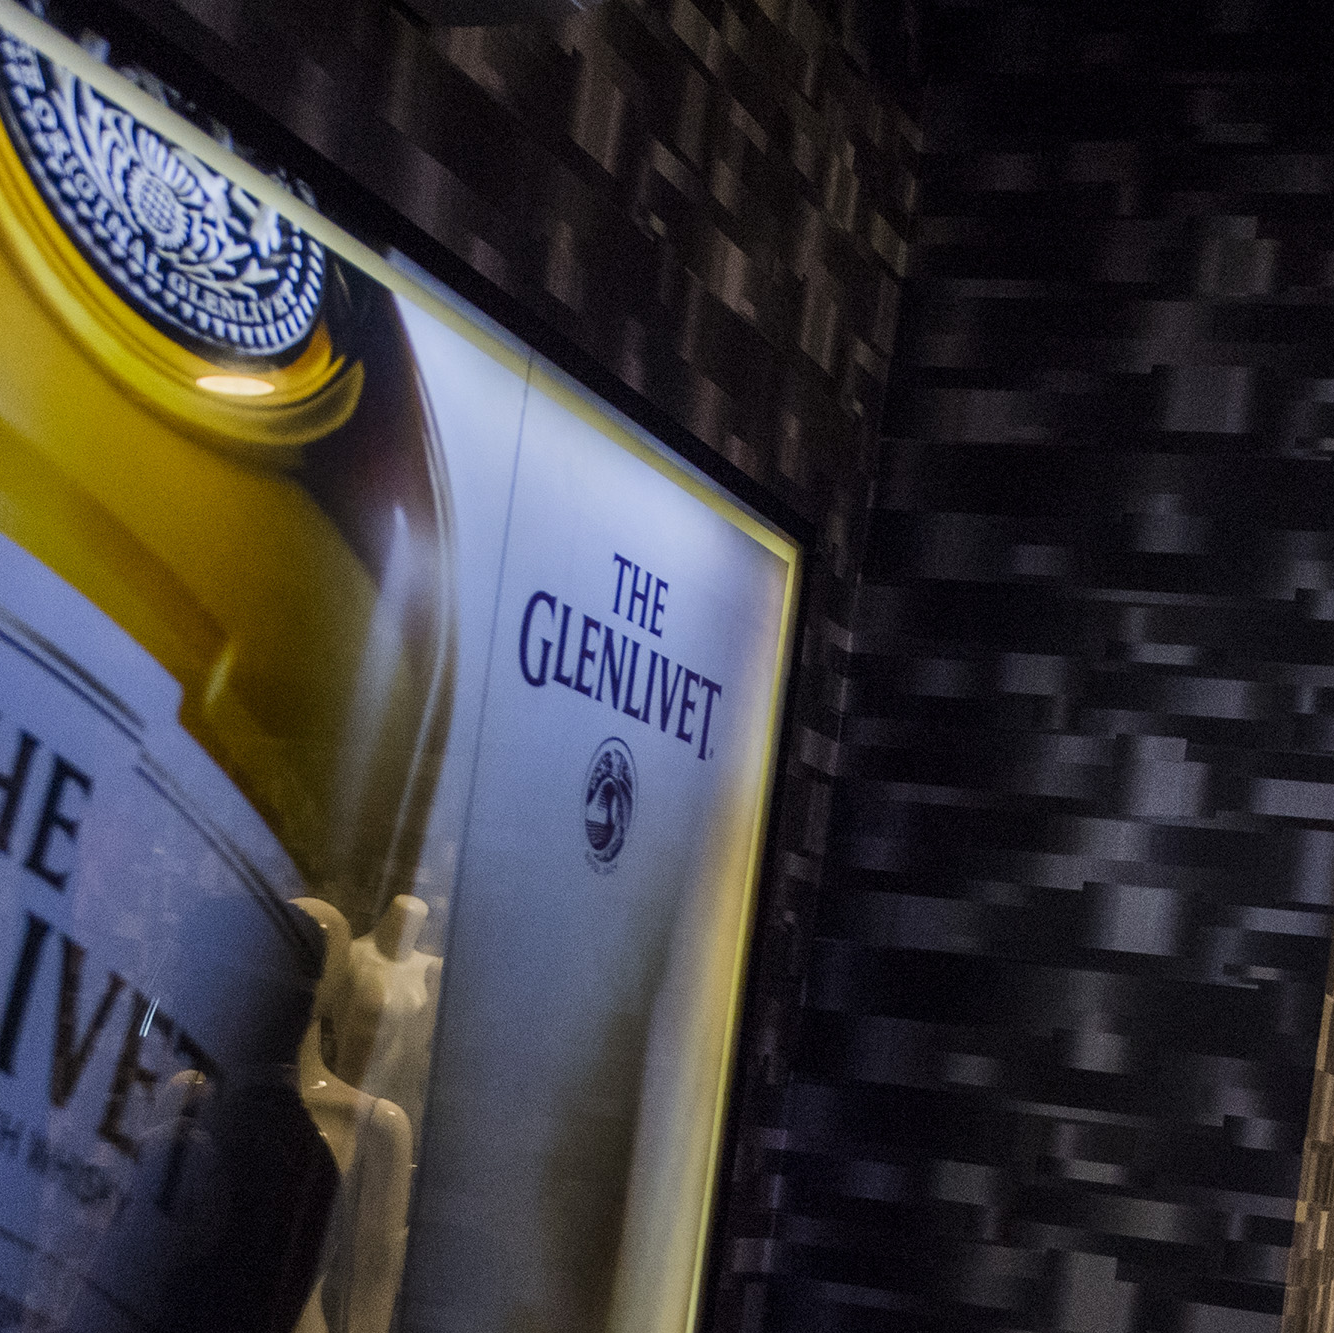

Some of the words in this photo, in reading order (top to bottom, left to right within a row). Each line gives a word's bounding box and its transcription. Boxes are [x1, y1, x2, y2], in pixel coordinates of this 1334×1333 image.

[167, 270, 298, 323] GLENLIVET
[613, 551, 669, 638] THE
[518, 590, 722, 761] GLENLIVET
